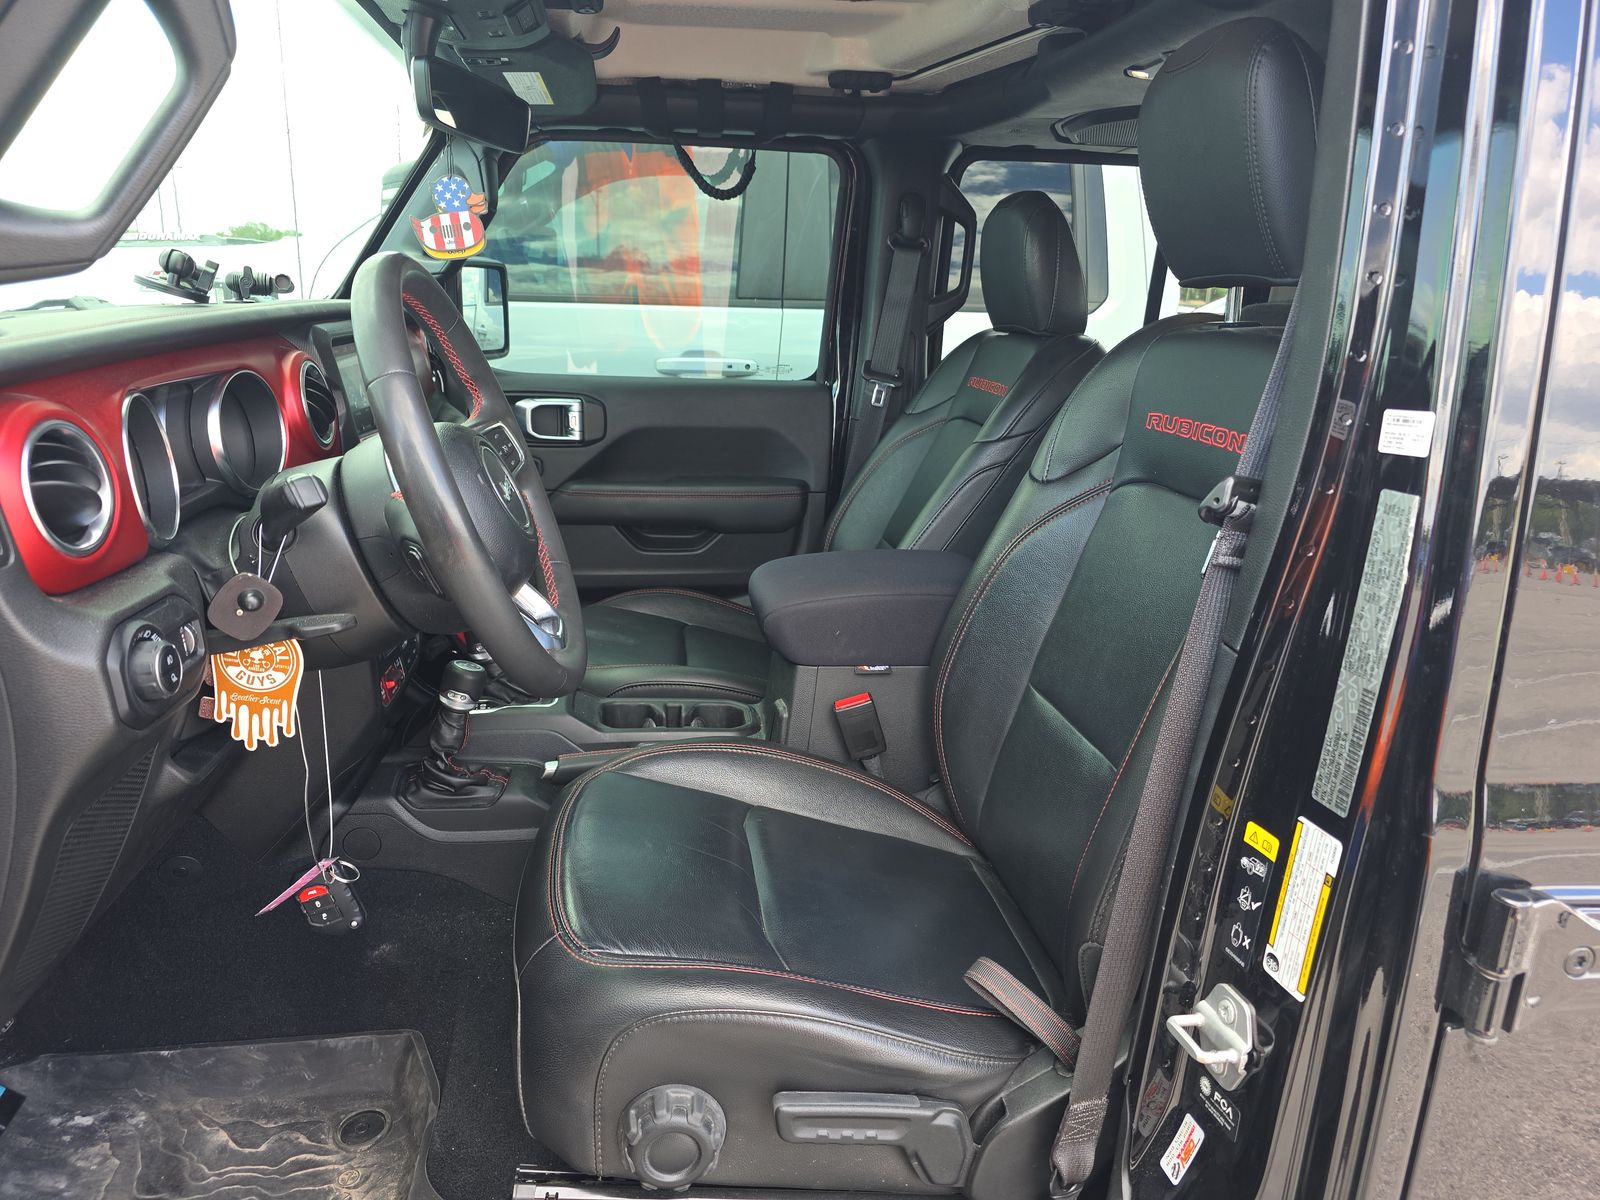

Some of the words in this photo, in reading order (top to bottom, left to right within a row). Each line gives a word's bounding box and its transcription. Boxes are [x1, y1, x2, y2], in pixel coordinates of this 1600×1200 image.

[1145, 411, 1248, 454] RUBICON
[235, 670, 277, 687] GUYS
[230, 692, 259, 702] Leather
[259, 696, 282, 705] Scent
[1213, 1090, 1233, 1120] FCA
